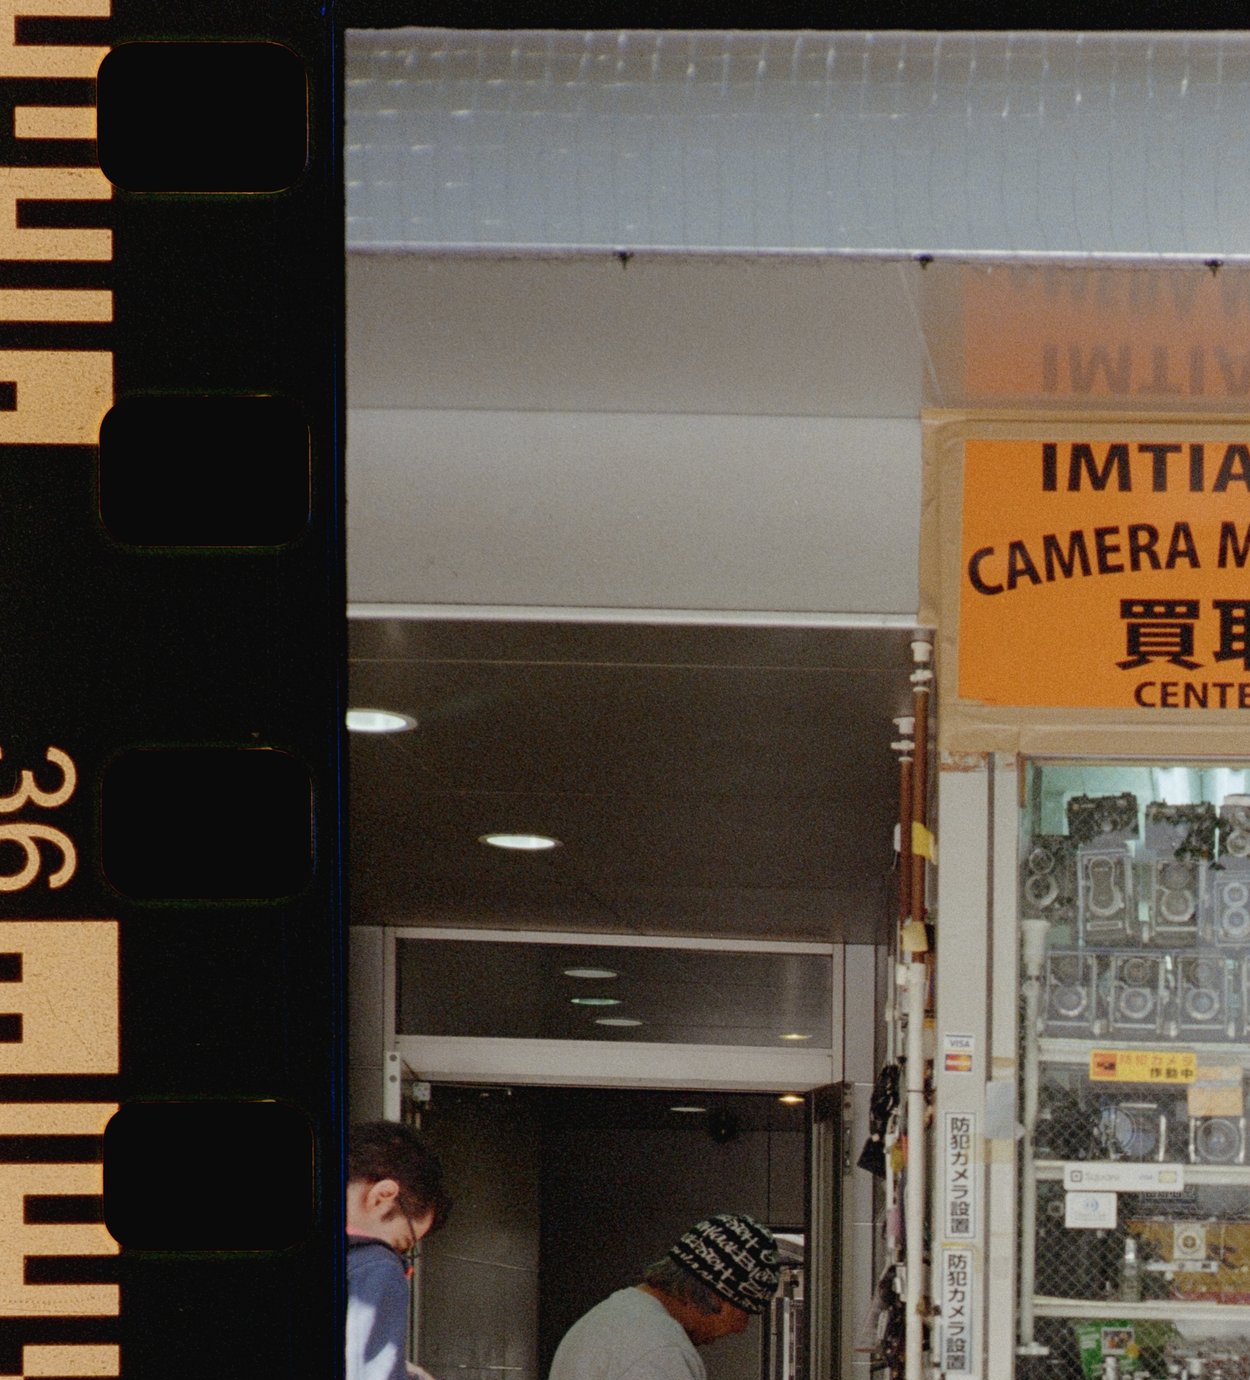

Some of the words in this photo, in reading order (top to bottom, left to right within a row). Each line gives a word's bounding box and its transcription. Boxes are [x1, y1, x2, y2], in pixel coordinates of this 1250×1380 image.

[968, 522, 1200, 596] CAMERA
[0, 747, 77, 891] 36
[950, 1040, 970, 1048] VISA
[950, 1116, 970, 1235] 防犯カメラ設置
[946, 1253, 968, 1371] 防犯カメラ設置
